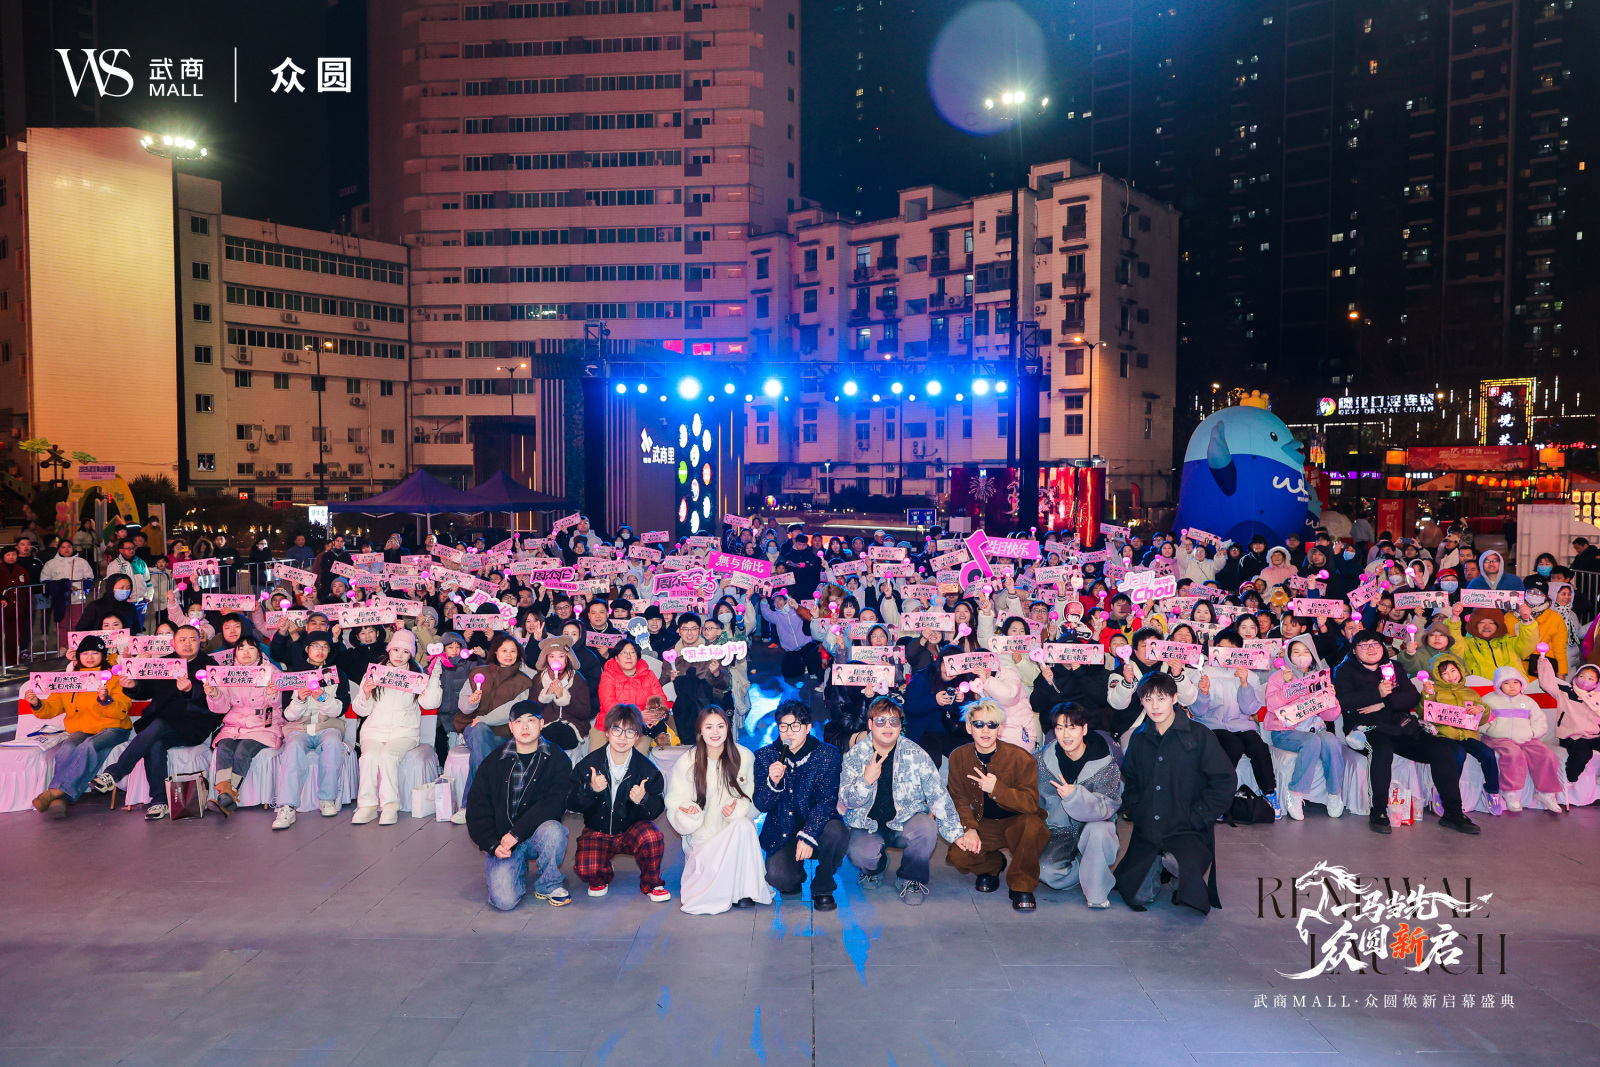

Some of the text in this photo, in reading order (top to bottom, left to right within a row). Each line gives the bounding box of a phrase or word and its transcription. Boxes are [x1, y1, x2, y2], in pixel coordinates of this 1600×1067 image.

[986, 540, 1030, 558] 生日快乐
[715, 554, 764, 573] 無与倫比
[1120, 572, 1152, 589] Jay
[1133, 584, 1174, 602] Chou
[726, 644, 744, 662] Jay
